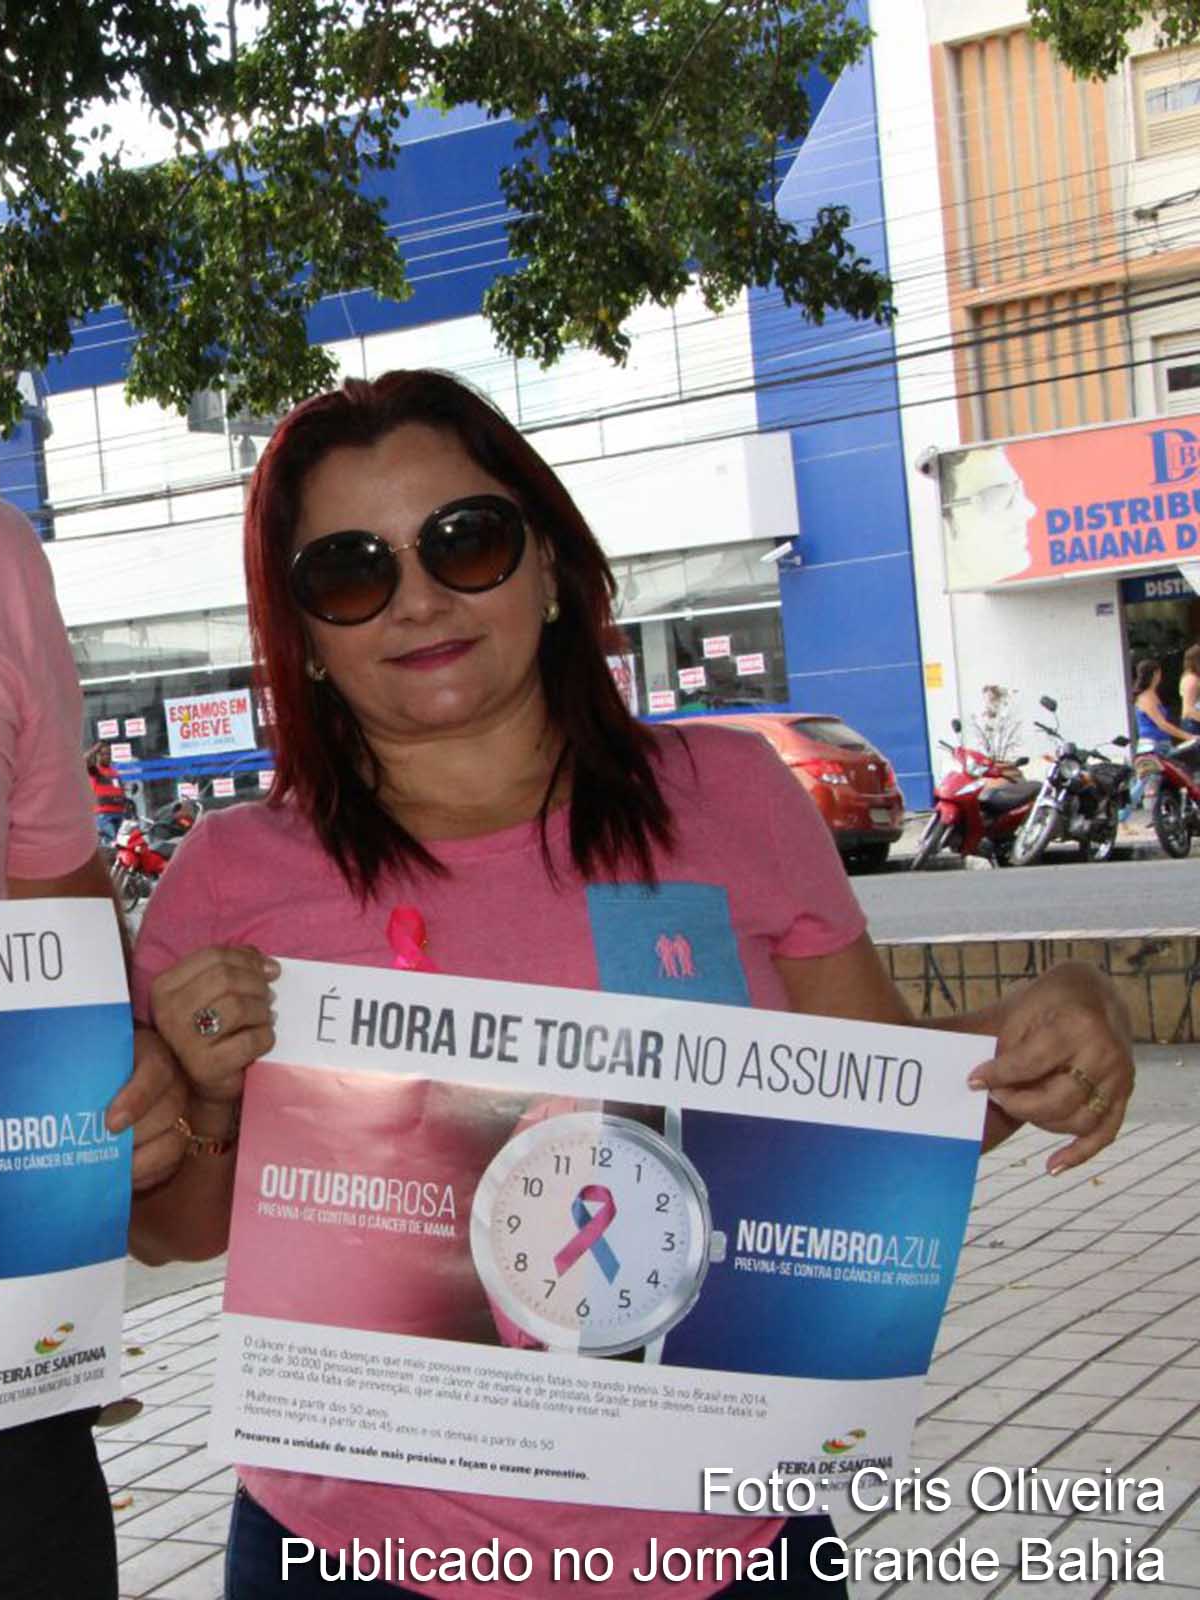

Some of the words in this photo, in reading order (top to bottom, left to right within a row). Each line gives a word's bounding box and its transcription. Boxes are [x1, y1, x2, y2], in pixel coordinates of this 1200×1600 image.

[1049, 527, 1166, 566] BAIANA
[169, 701, 228, 723] ESTAMOS
[230, 698, 247, 716] EM
[180, 718, 232, 740] GREVE
[316, 986, 341, 1044] É
[350, 997, 457, 1057] HORA
[469, 1011, 522, 1063] DE
[534, 1018, 664, 1080] TOCAR
[674, 1033, 727, 1086] NO
[737, 1041, 922, 1107] ASSUNTO
[23, 1154, 61, 1170] CÂNCER
[62, 1152, 74, 1166] DE
[554, 1155, 571, 1176] 11
[590, 1147, 613, 1168] 12
[634, 1164, 643, 1184] 1
[522, 1177, 544, 1198] 10
[656, 1193, 670, 1213] 2
[367, 1215, 407, 1233] CÂNCER
[408, 1220, 422, 1235] DE
[423, 1222, 456, 1238] MAMA
[507, 1215, 521, 1234] 9
[661, 1232, 676, 1252] 3
[514, 1253, 528, 1272] 8
[734, 1257, 793, 1276] PREVINA-SE
[794, 1263, 832, 1281] CONTRA
[842, 1268, 881, 1285] CÂNCER
[882, 1271, 895, 1286] DE
[543, 1279, 557, 1299] 7
[646, 1270, 661, 1289] 4
[576, 1298, 591, 1318] 6
[618, 1290, 632, 1309] 5
[34, 1361, 50, 1376] DE
[52, 1346, 106, 1371] SANTANA
[234, 1428, 281, 1445] Procurem
[292, 1437, 331, 1451] unidade
[333, 1442, 347, 1453] de
[349, 1444, 378, 1458] saúde
[380, 1449, 404, 1461] mais
[406, 1450, 448, 1467] próxima
[458, 1456, 488, 1472] façam
[499, 1463, 532, 1476] exame
[777, 1461, 816, 1475] FEIRA
[818, 1461, 835, 1475] DE
